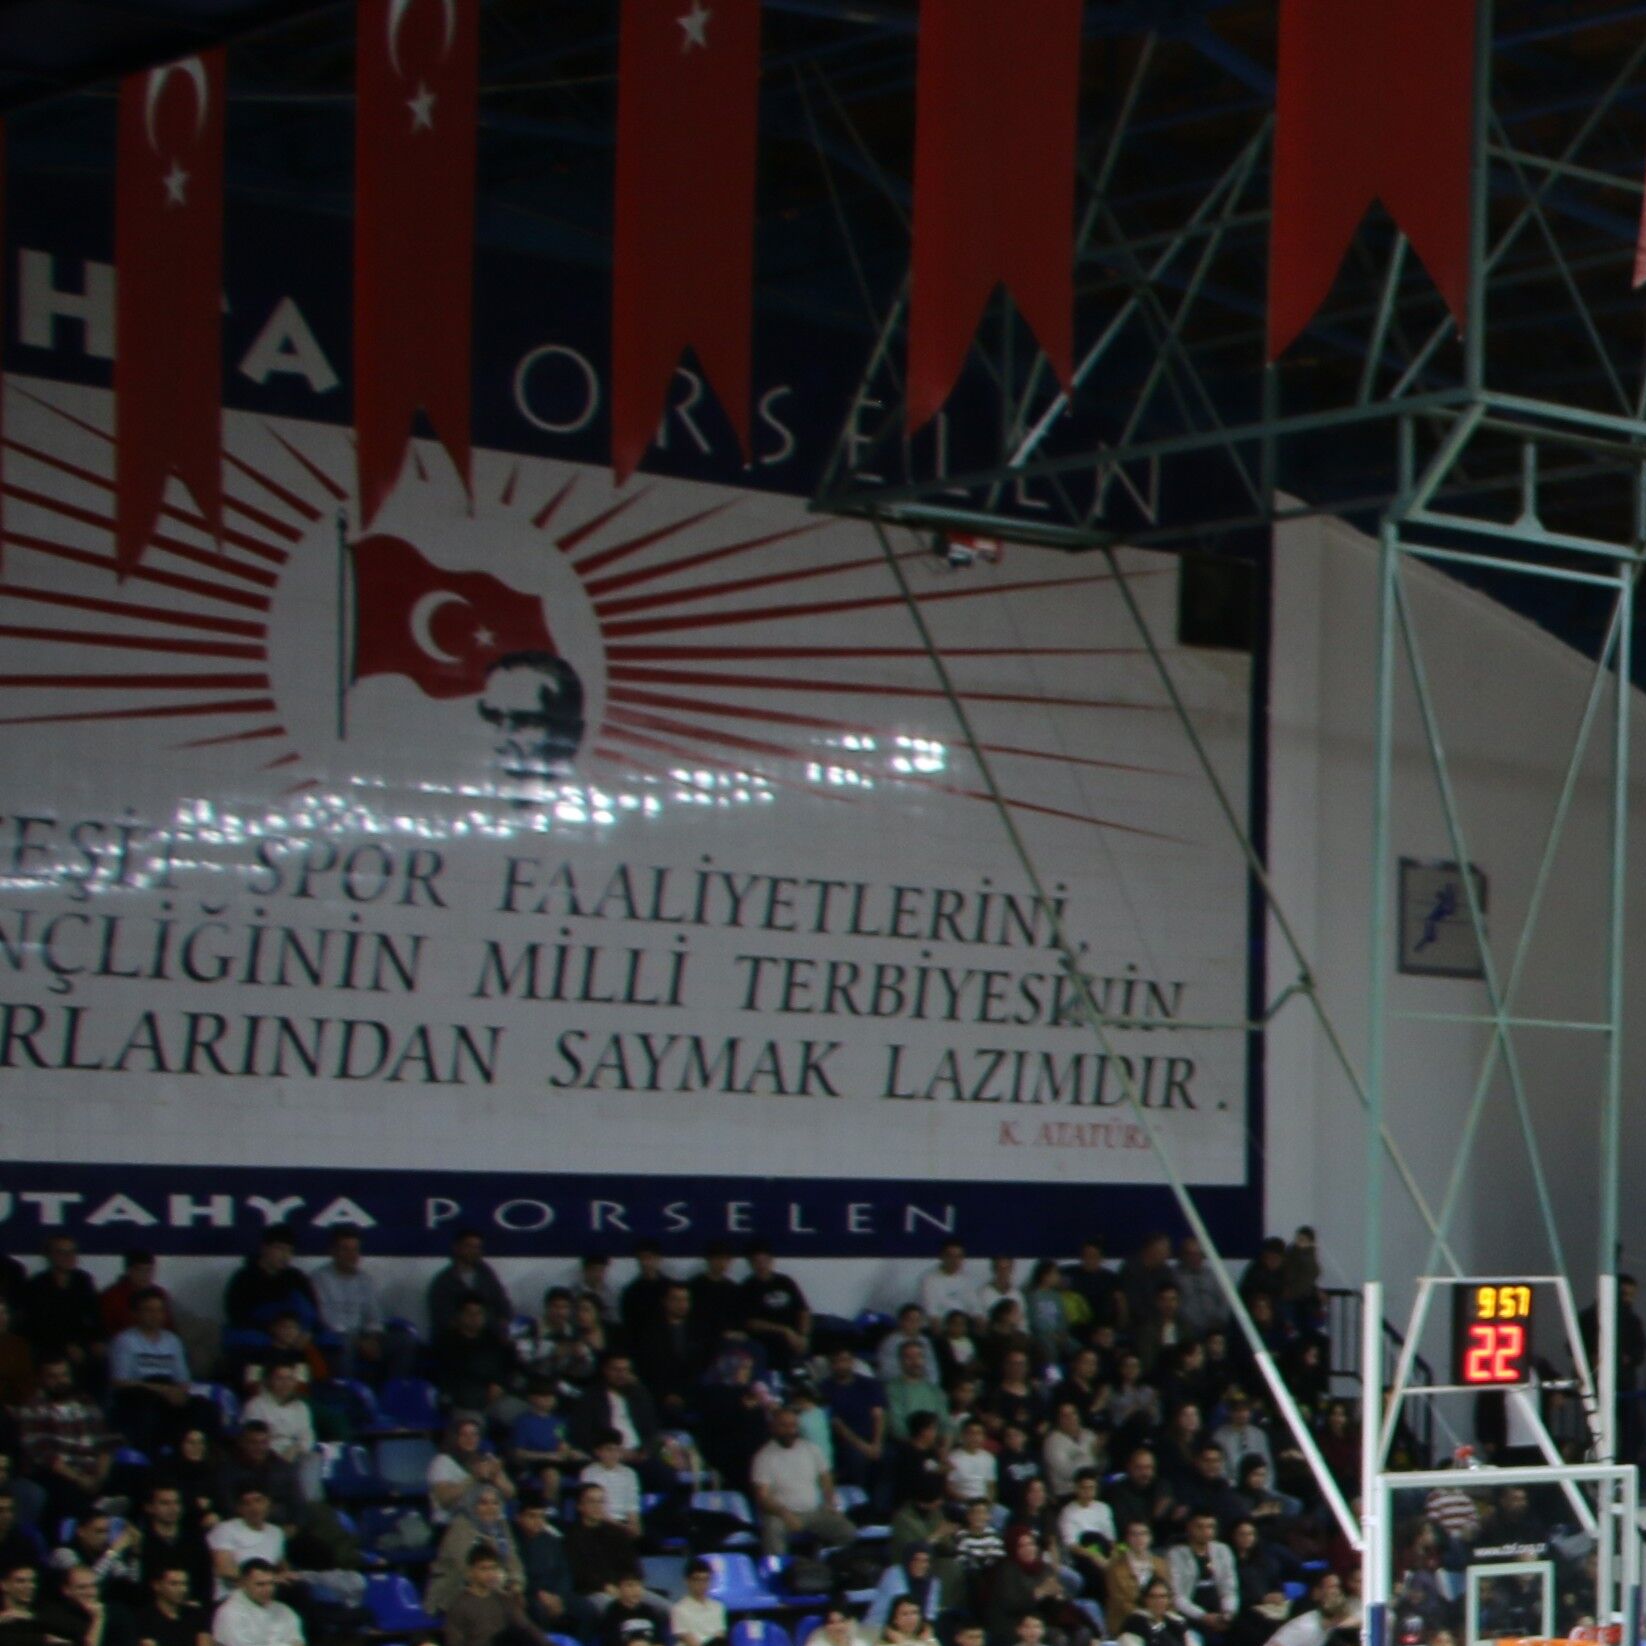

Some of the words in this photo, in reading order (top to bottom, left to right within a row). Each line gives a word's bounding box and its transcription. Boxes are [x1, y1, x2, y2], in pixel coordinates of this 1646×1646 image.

[18, 247, 341, 395] HA
[246, 836, 449, 909] SPOR
[470, 926, 688, 1008] MİLLİ
[549, 1028, 843, 1098] SAYMAK
[0, 1191, 378, 1227] TAHYA
[426, 1197, 956, 1233] PORSELEN
[1464, 1325, 1525, 1382] 22
